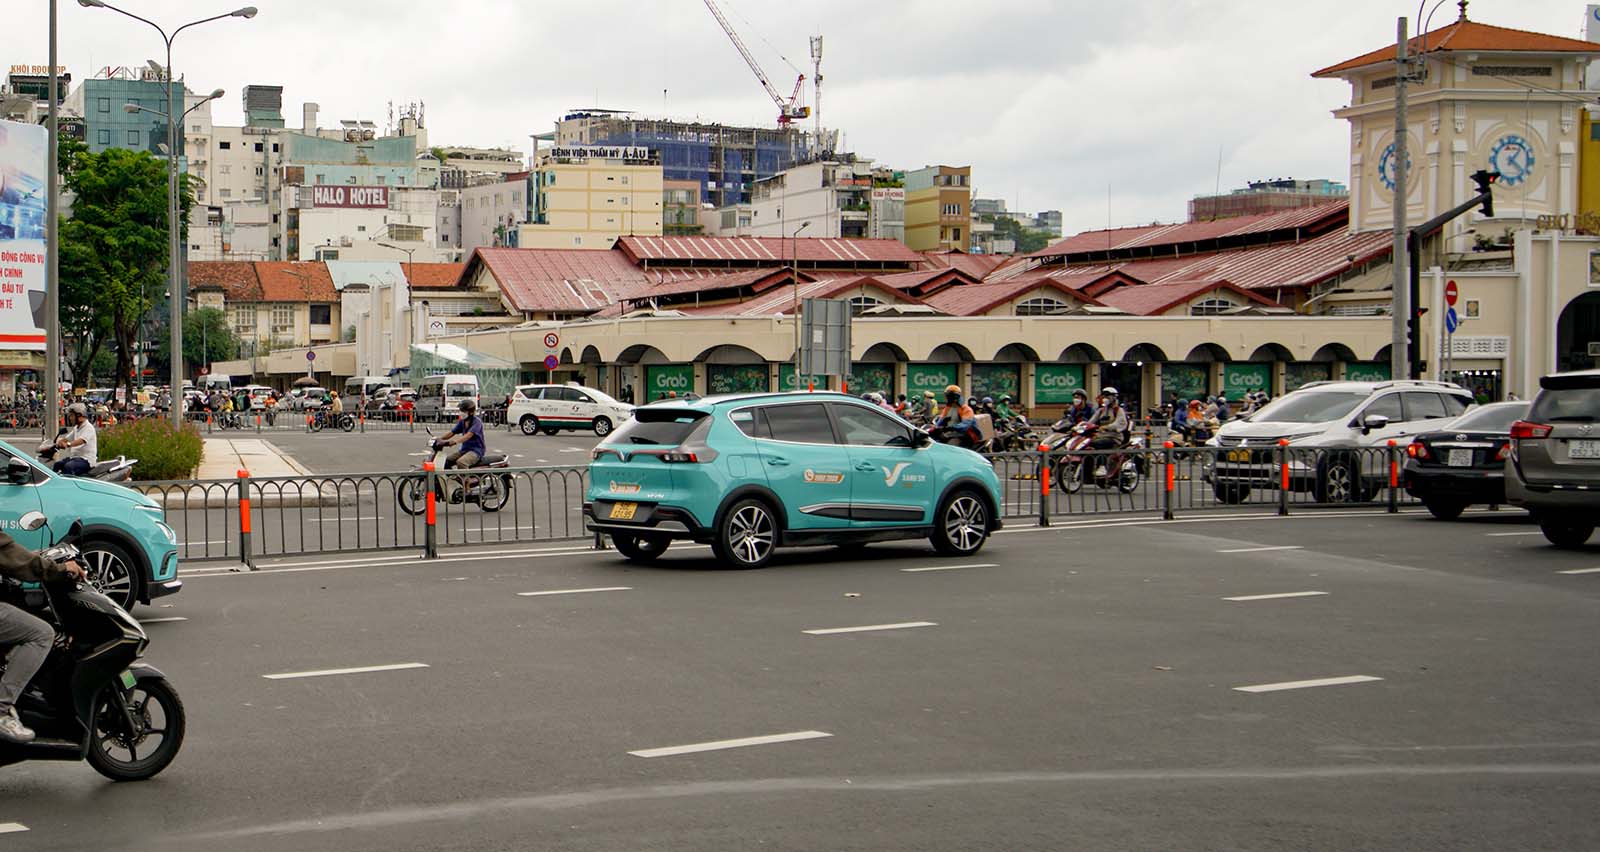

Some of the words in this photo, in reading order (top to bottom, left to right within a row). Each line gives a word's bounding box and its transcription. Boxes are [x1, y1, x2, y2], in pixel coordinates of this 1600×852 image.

[32, 65, 66, 74] ROOOP
[314, 187, 344, 204] HALO
[350, 188, 386, 205] HOTEL
[656, 373, 688, 388] Grab
[914, 372, 949, 387] Grab
[1041, 372, 1076, 387] Grab
[1229, 372, 1264, 386] Grab
